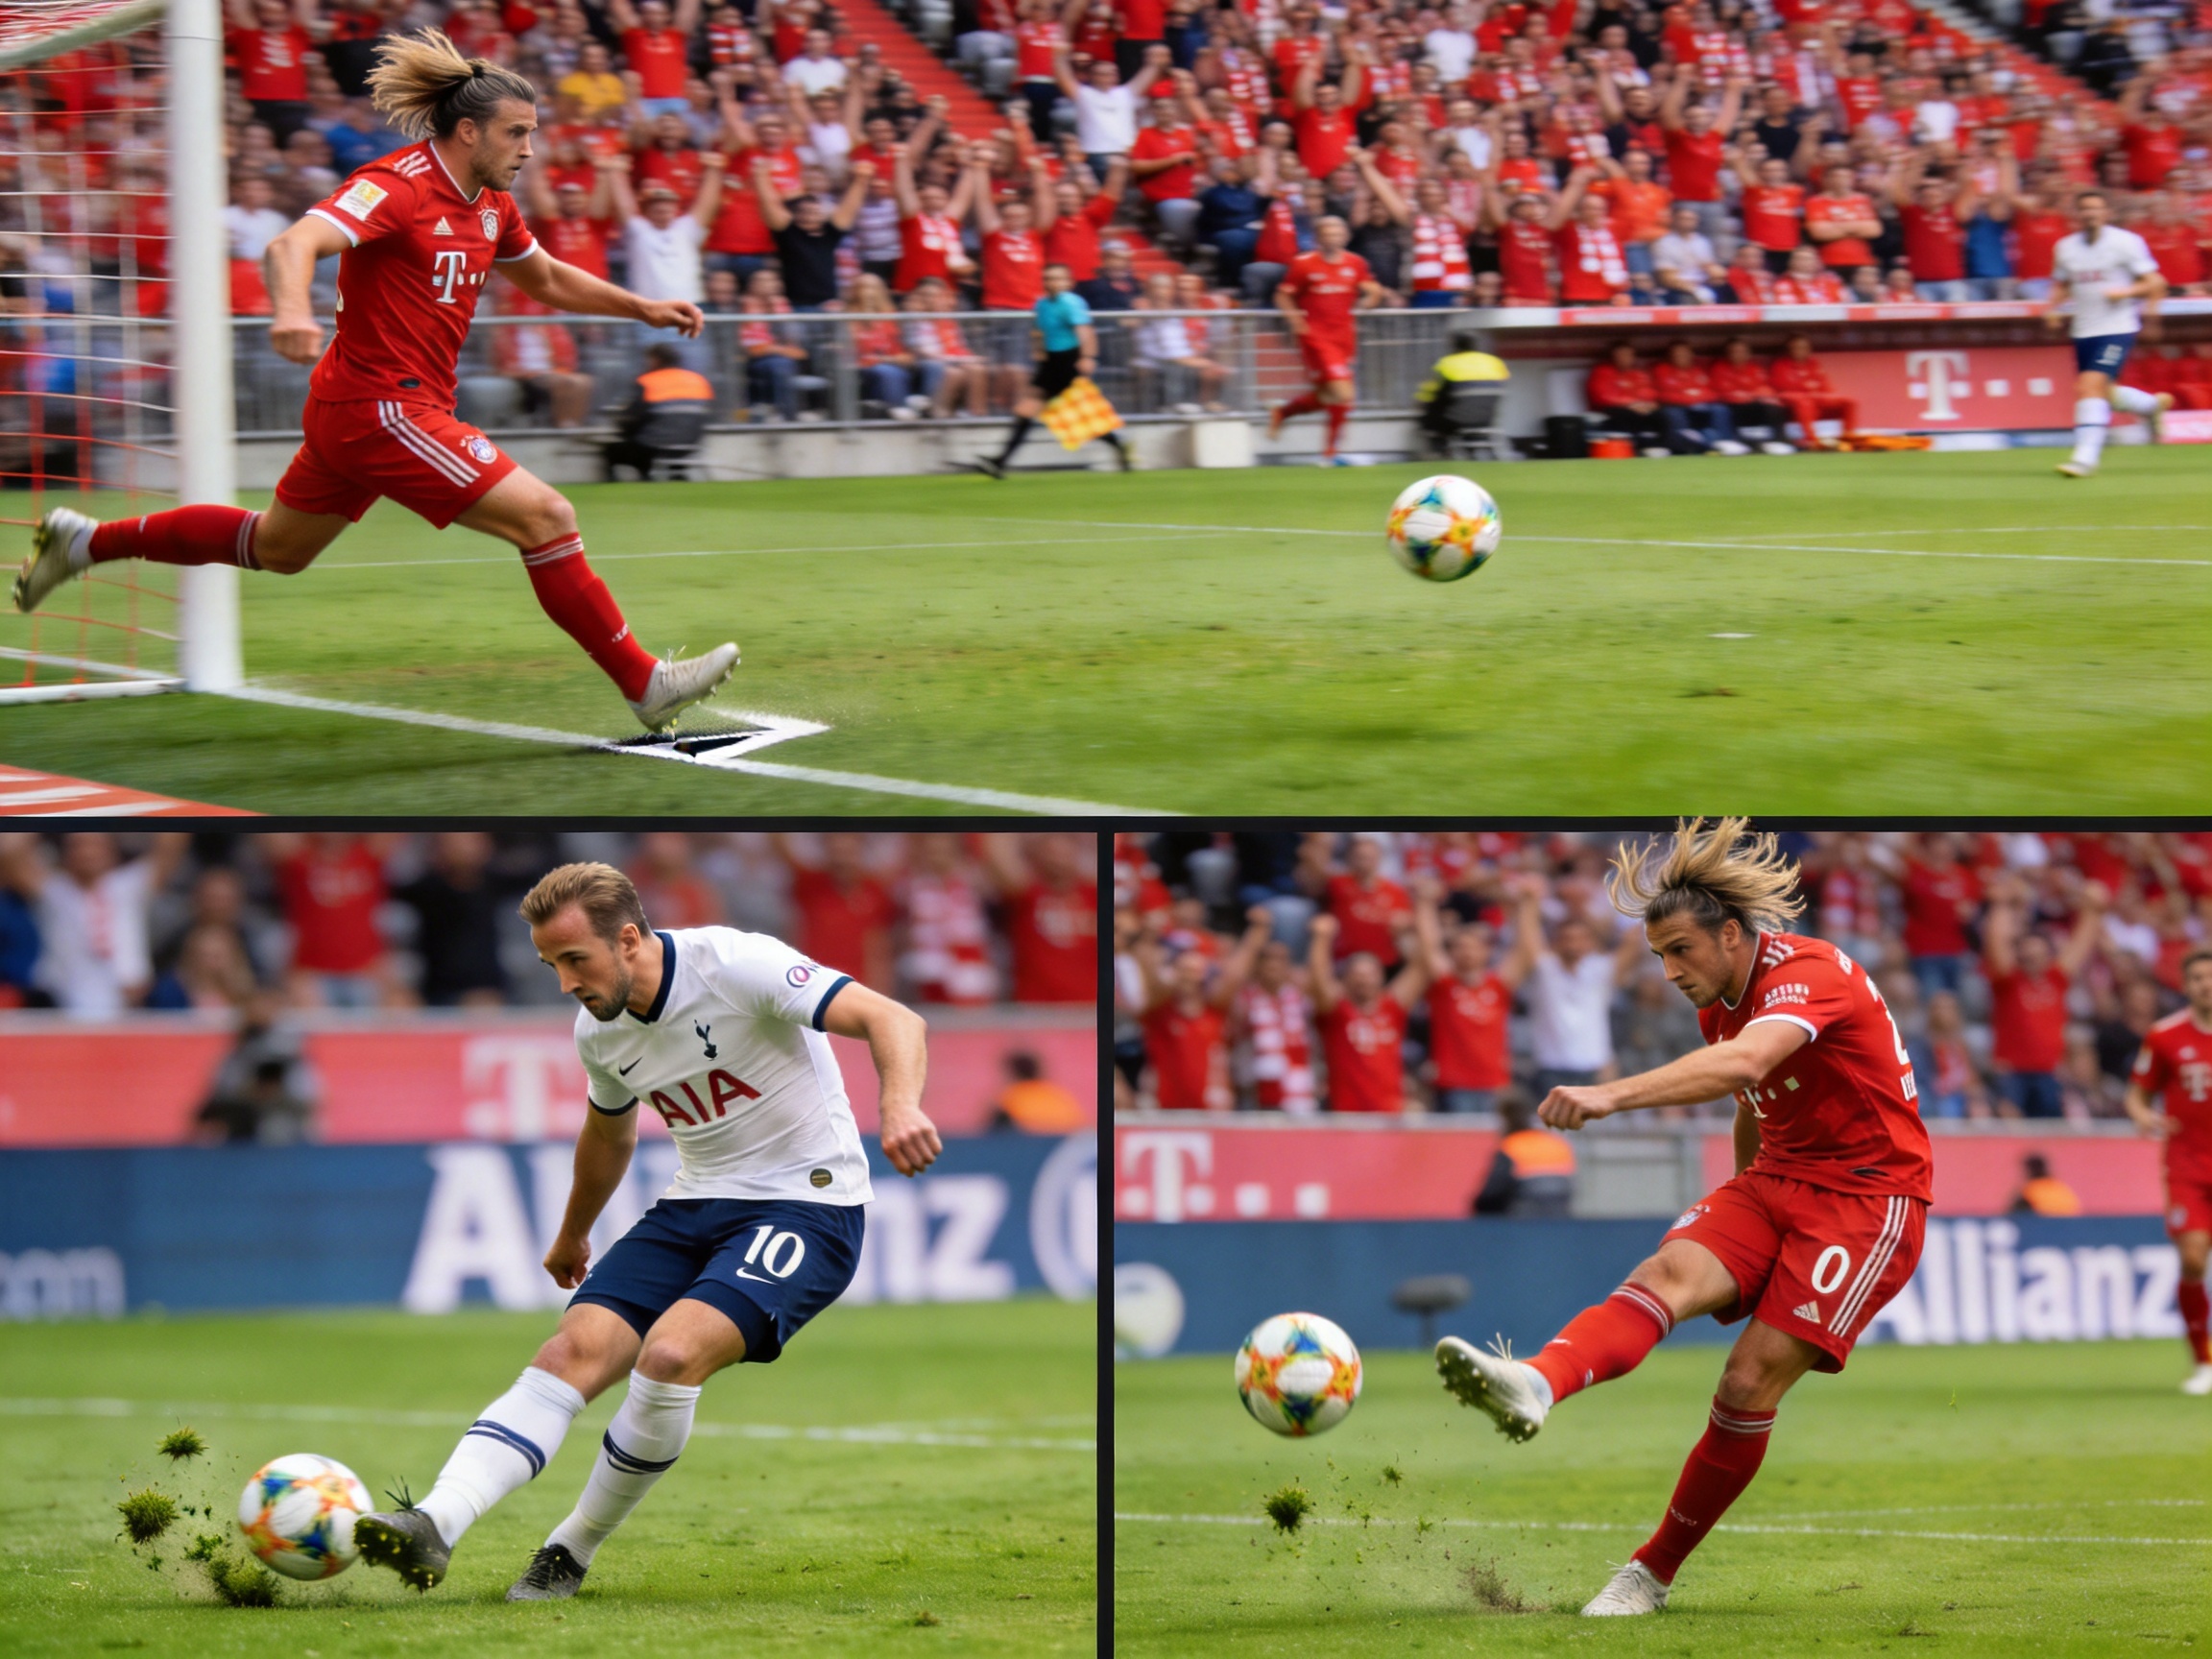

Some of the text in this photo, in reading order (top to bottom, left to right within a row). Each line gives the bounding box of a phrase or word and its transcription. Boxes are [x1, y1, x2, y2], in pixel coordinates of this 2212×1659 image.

[650, 1069, 762, 1128] AIA
[744, 1225, 805, 1279] 10
[1812, 1245, 1851, 1294] 0
